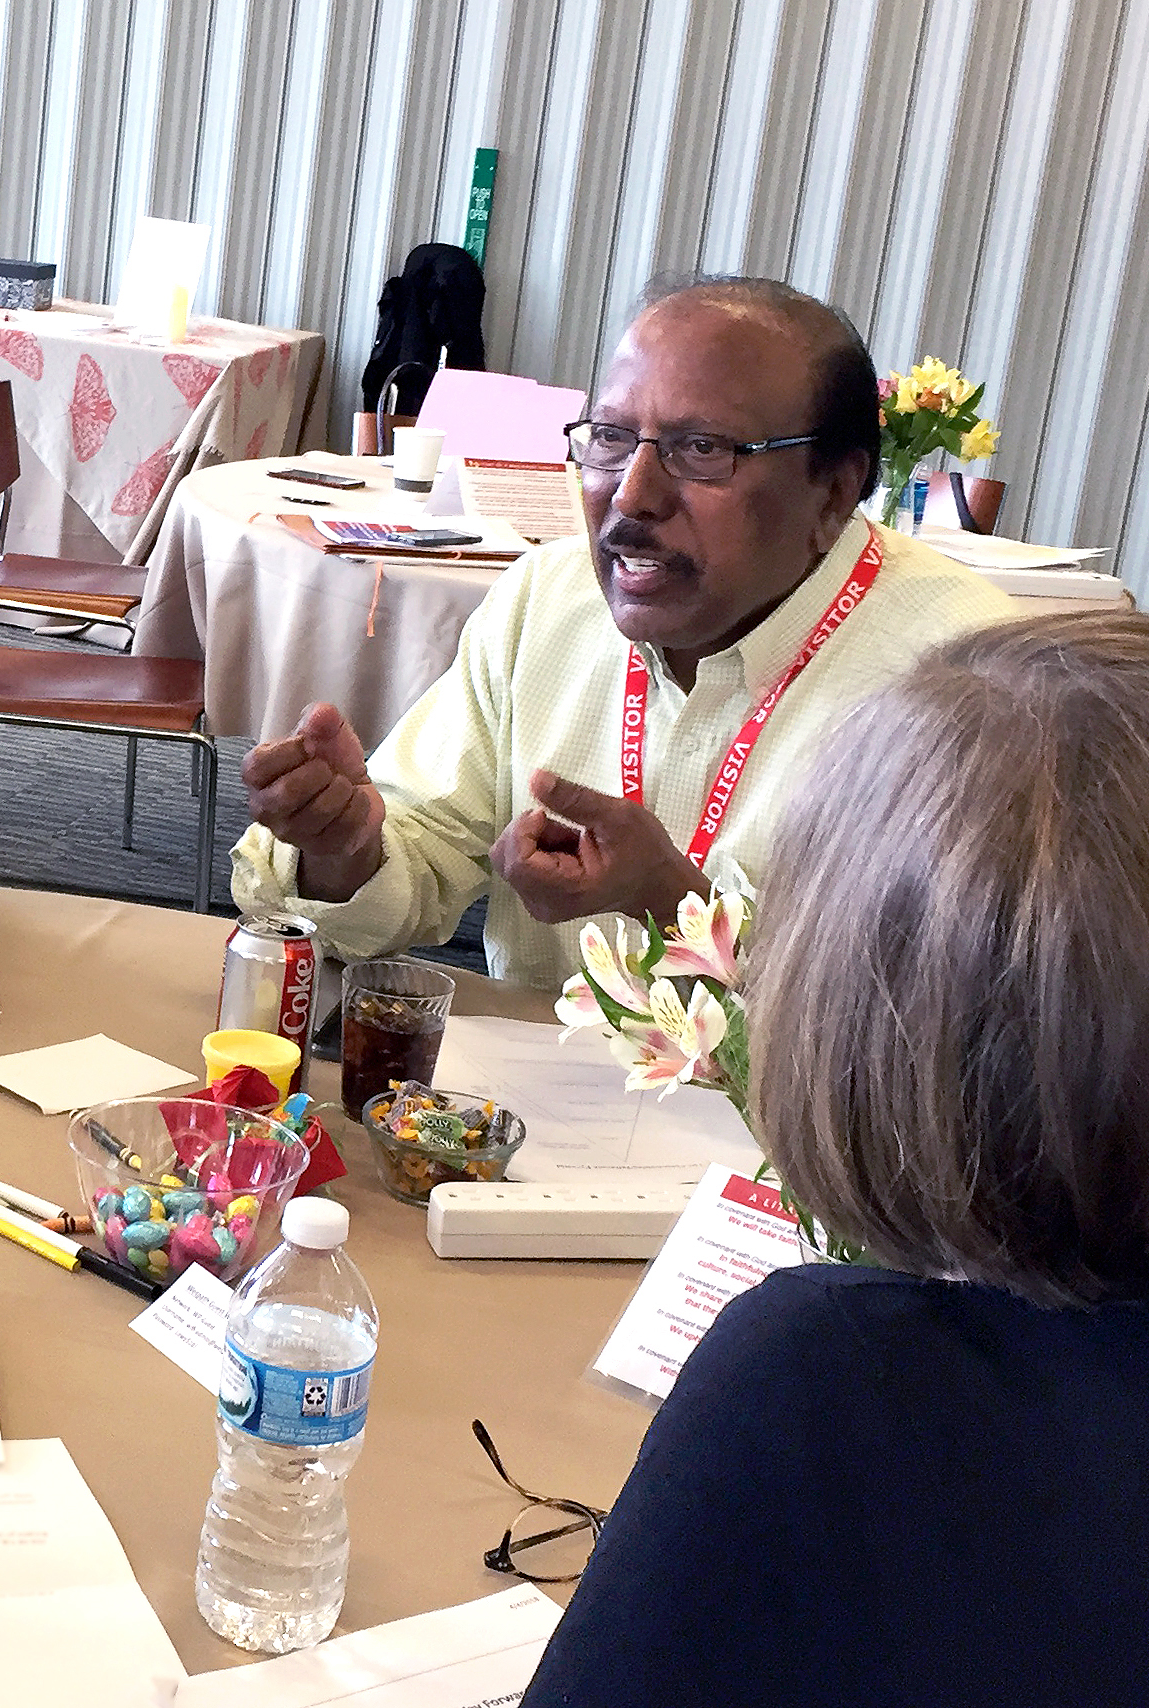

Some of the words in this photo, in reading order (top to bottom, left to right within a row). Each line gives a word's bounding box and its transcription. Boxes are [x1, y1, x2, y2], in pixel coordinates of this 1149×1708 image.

[469, 208, 489, 221] OPEN
[797, 581, 865, 665] VISITOR
[623, 693, 645, 795] VISITOR
[701, 741, 750, 834] VISITOR
[281, 957, 315, 1035] Coke
[748, 1193, 757, 1203] A
[728, 1215, 742, 1226] We
[758, 1227, 777, 1238] take
[685, 1284, 698, 1294] We
[699, 1291, 723, 1304] share
[670, 1324, 683, 1335] We
[482, 1690, 525, 1708] Forwar
